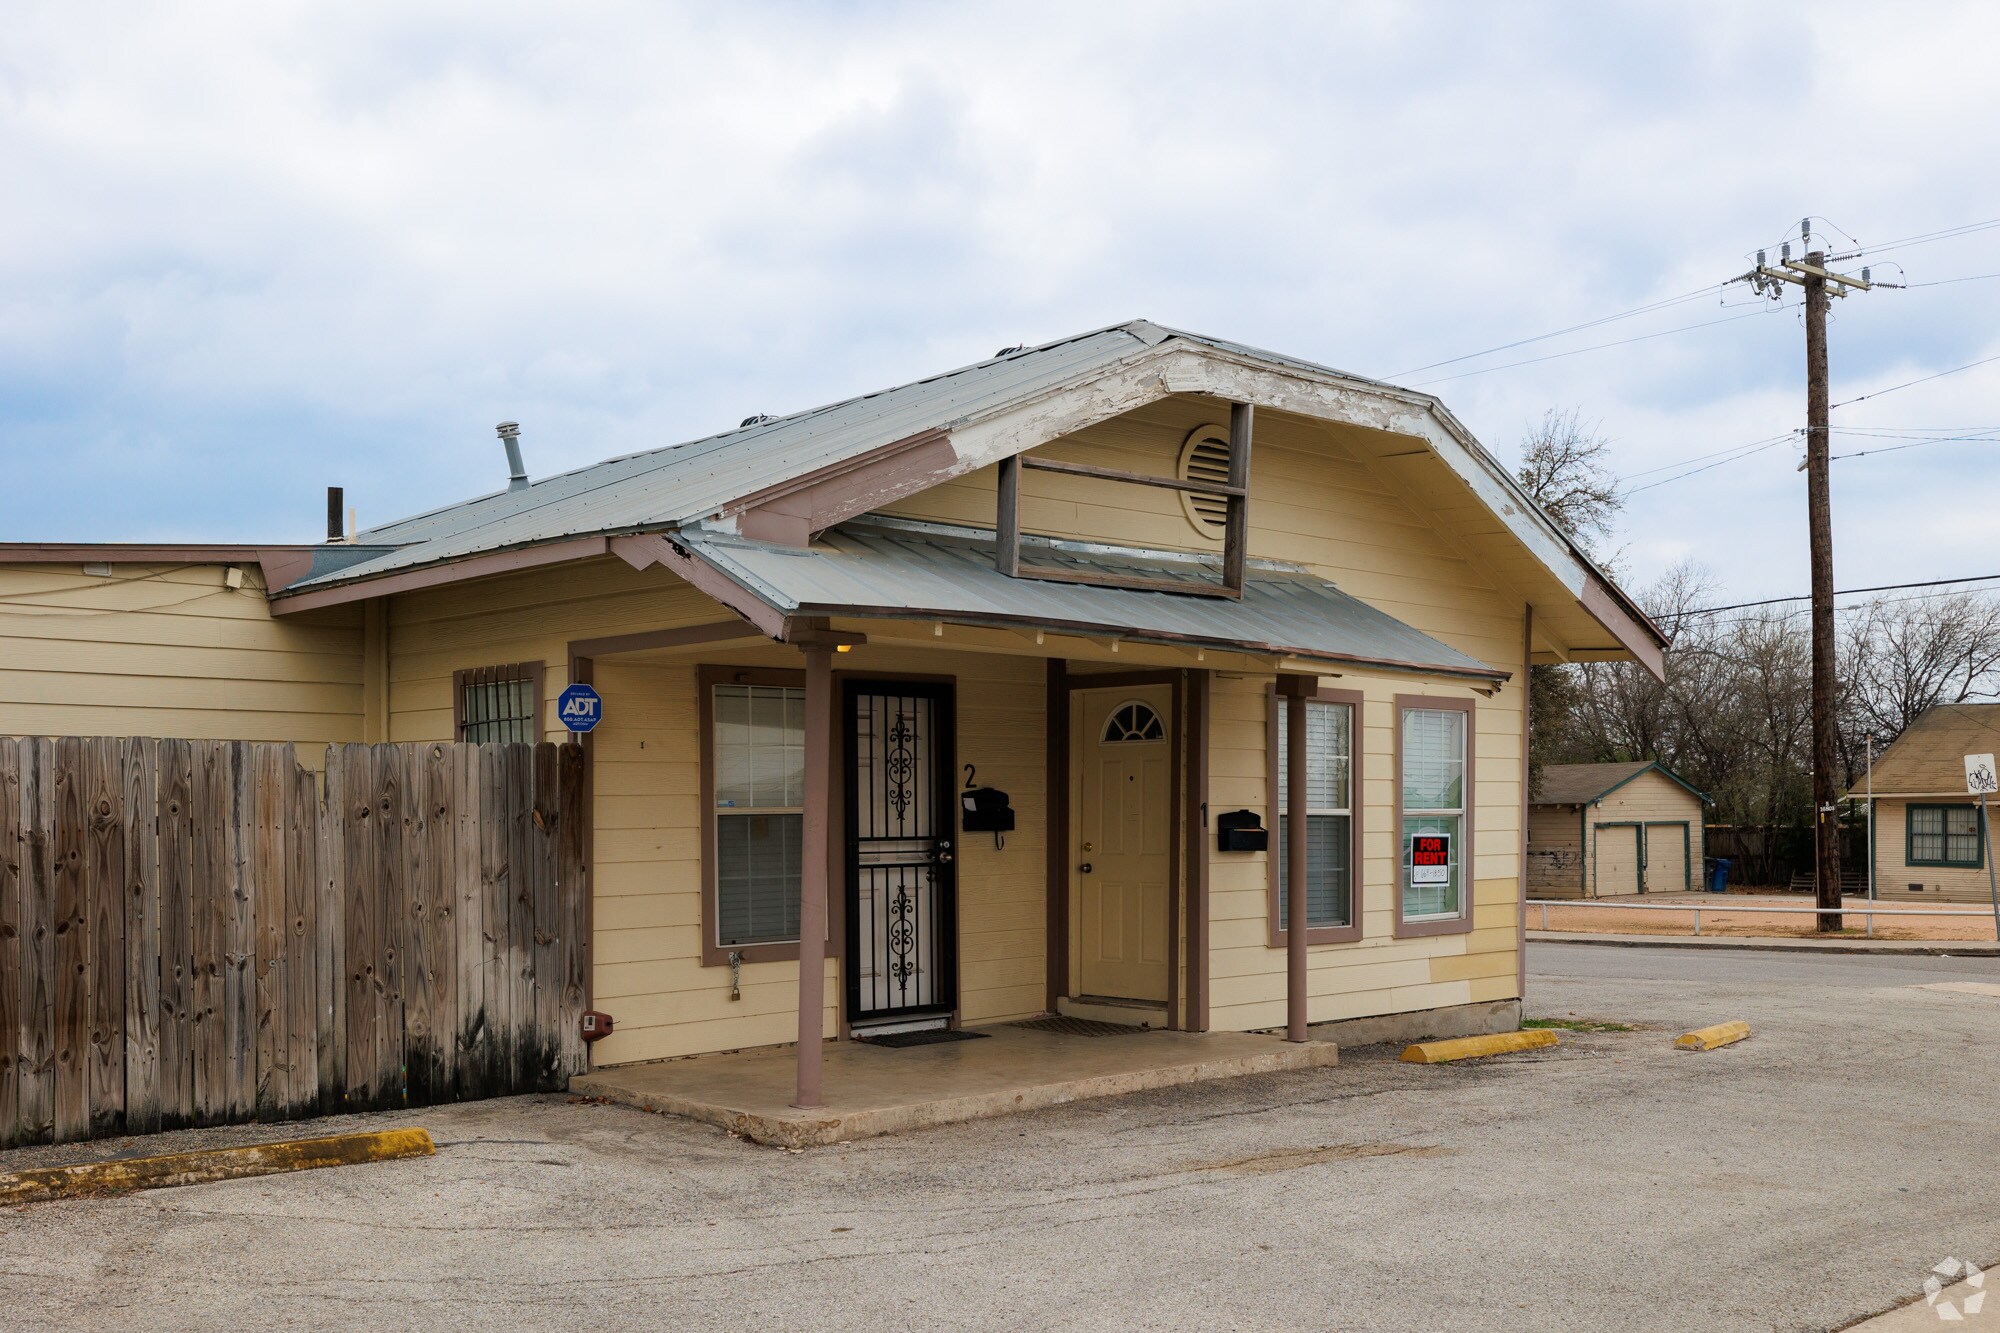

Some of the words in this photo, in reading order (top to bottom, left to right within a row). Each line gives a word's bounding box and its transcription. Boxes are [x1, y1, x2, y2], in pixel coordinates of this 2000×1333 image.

[562, 697, 598, 715] ADT
[964, 763, 977, 788] 2
[1200, 802, 1207, 827] 1
[1420, 838, 1441, 851] FOR
[1414, 852, 1446, 865] RENT
